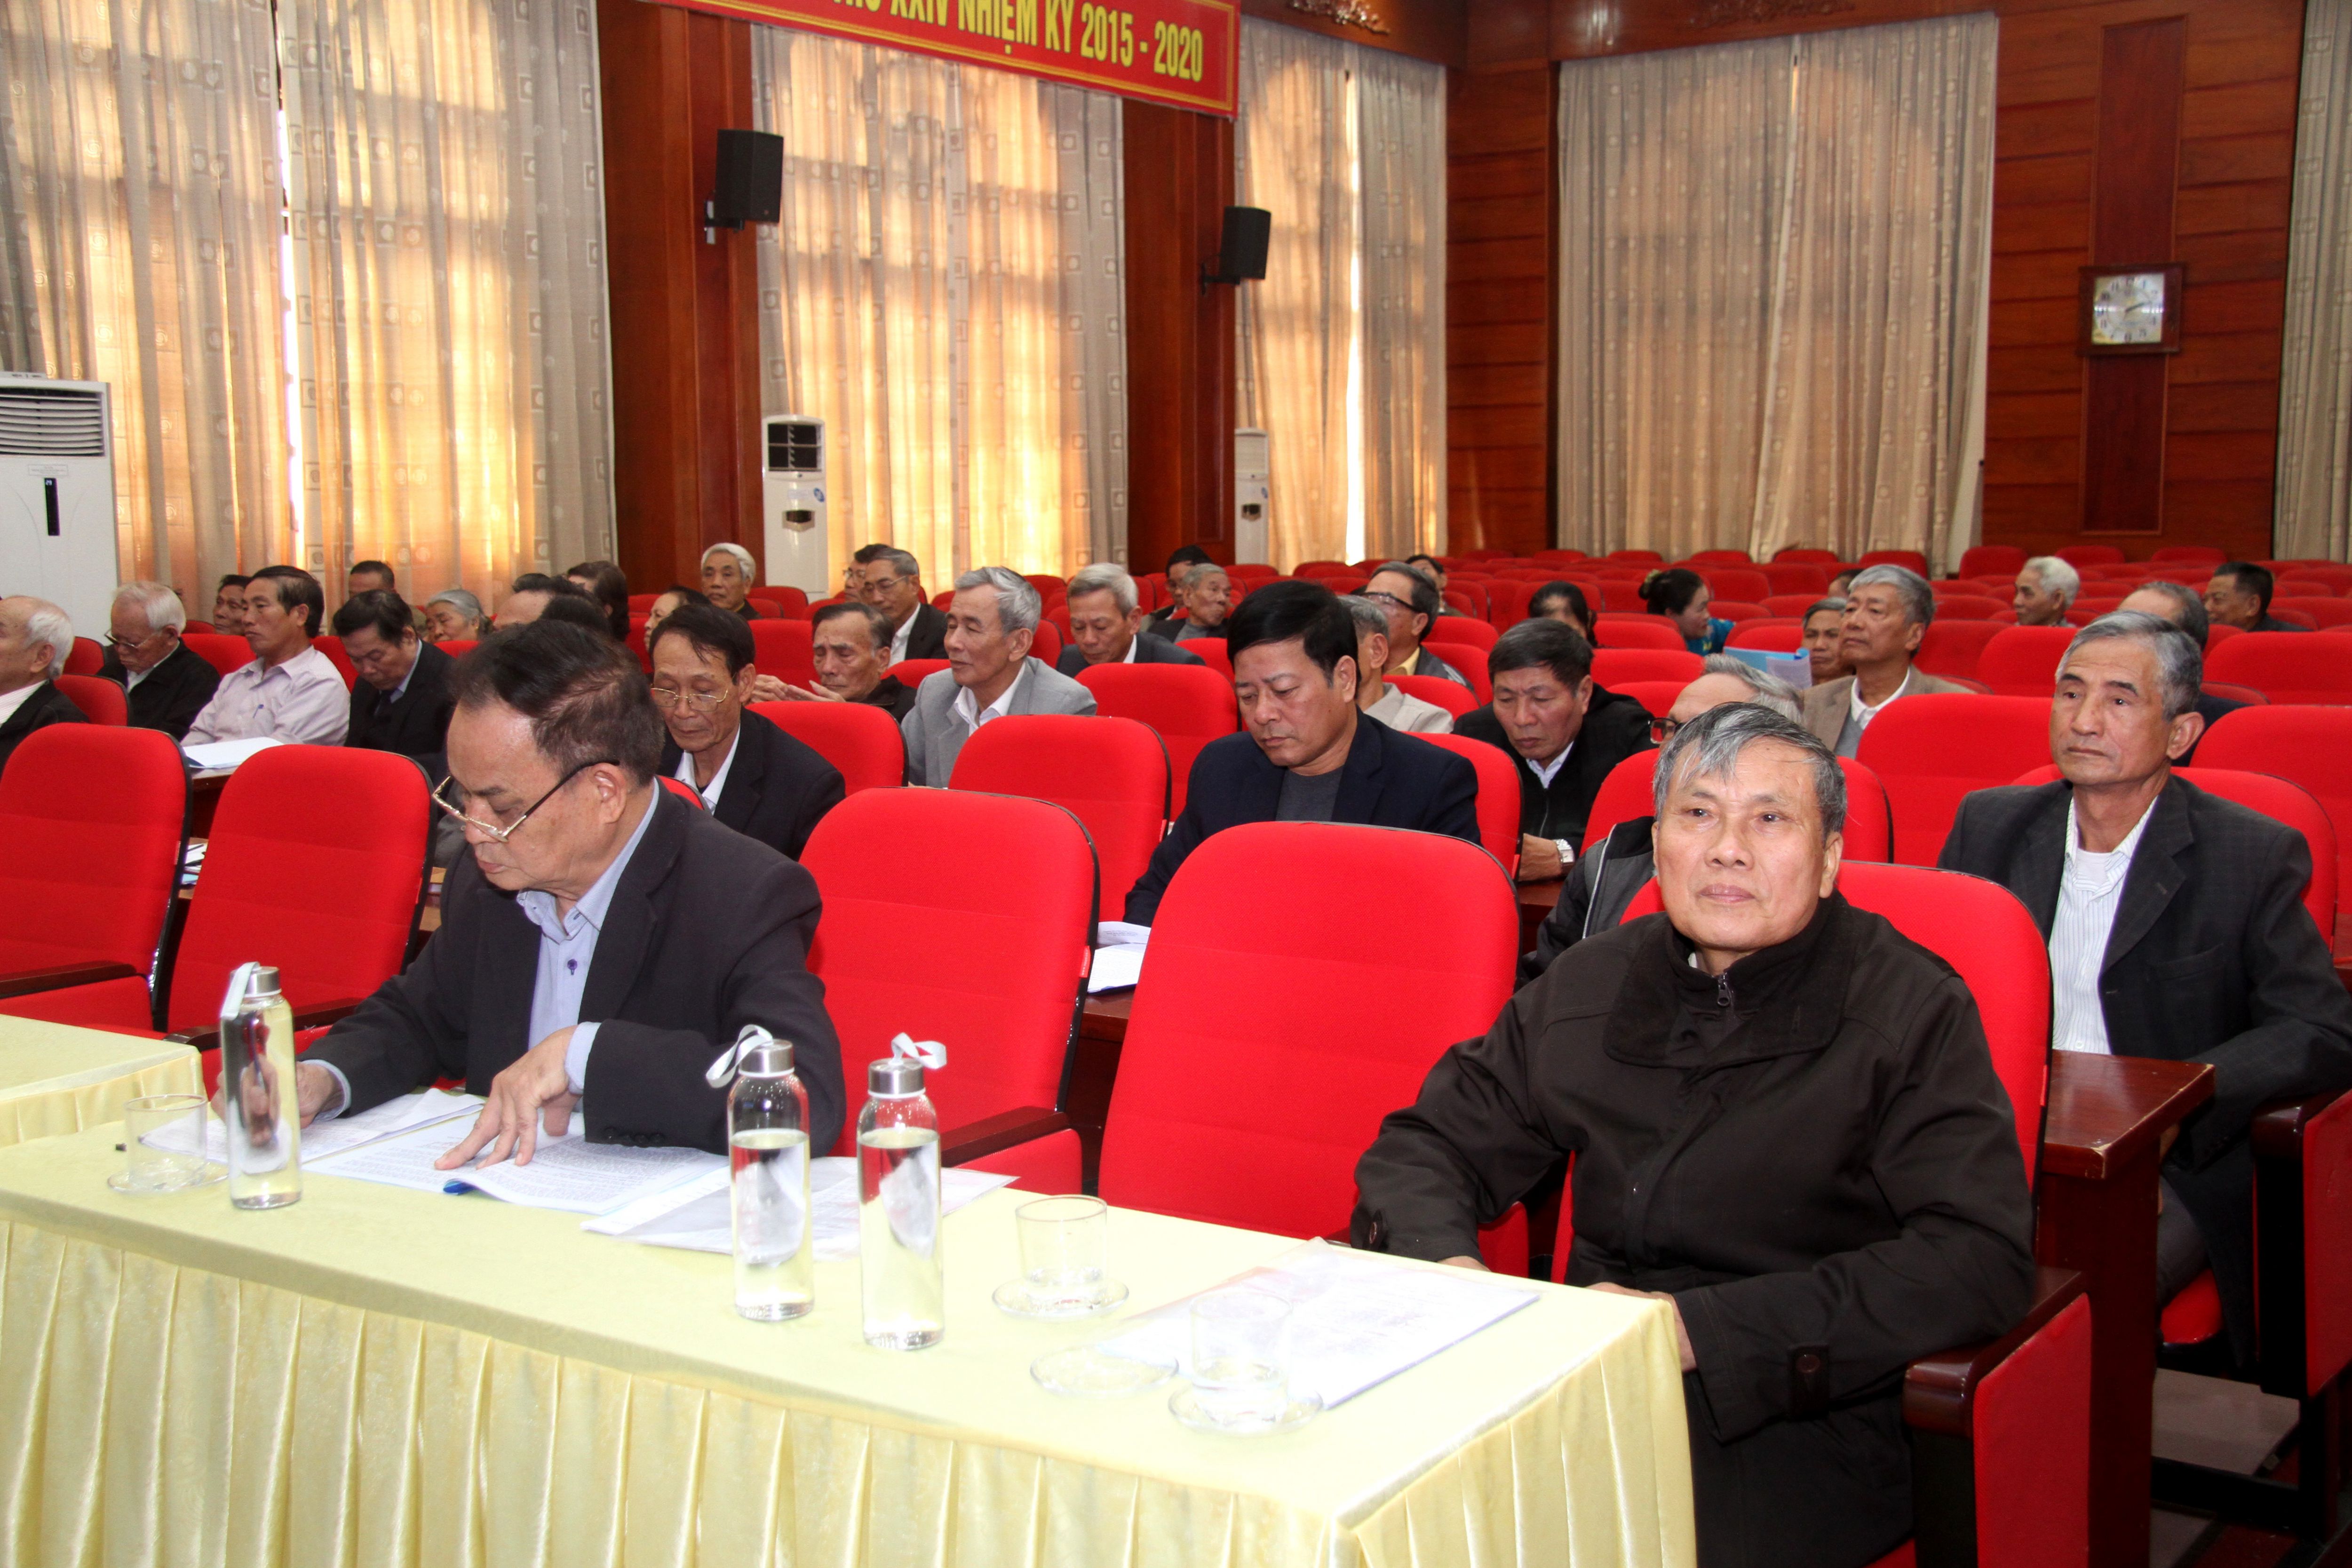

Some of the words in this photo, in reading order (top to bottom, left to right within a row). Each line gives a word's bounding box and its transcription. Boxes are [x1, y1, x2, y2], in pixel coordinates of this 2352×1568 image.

[1081, 2, 1134, 67] 2015
[1139, 41, 1148, 54] -
[1153, 20, 1203, 82] 2020
